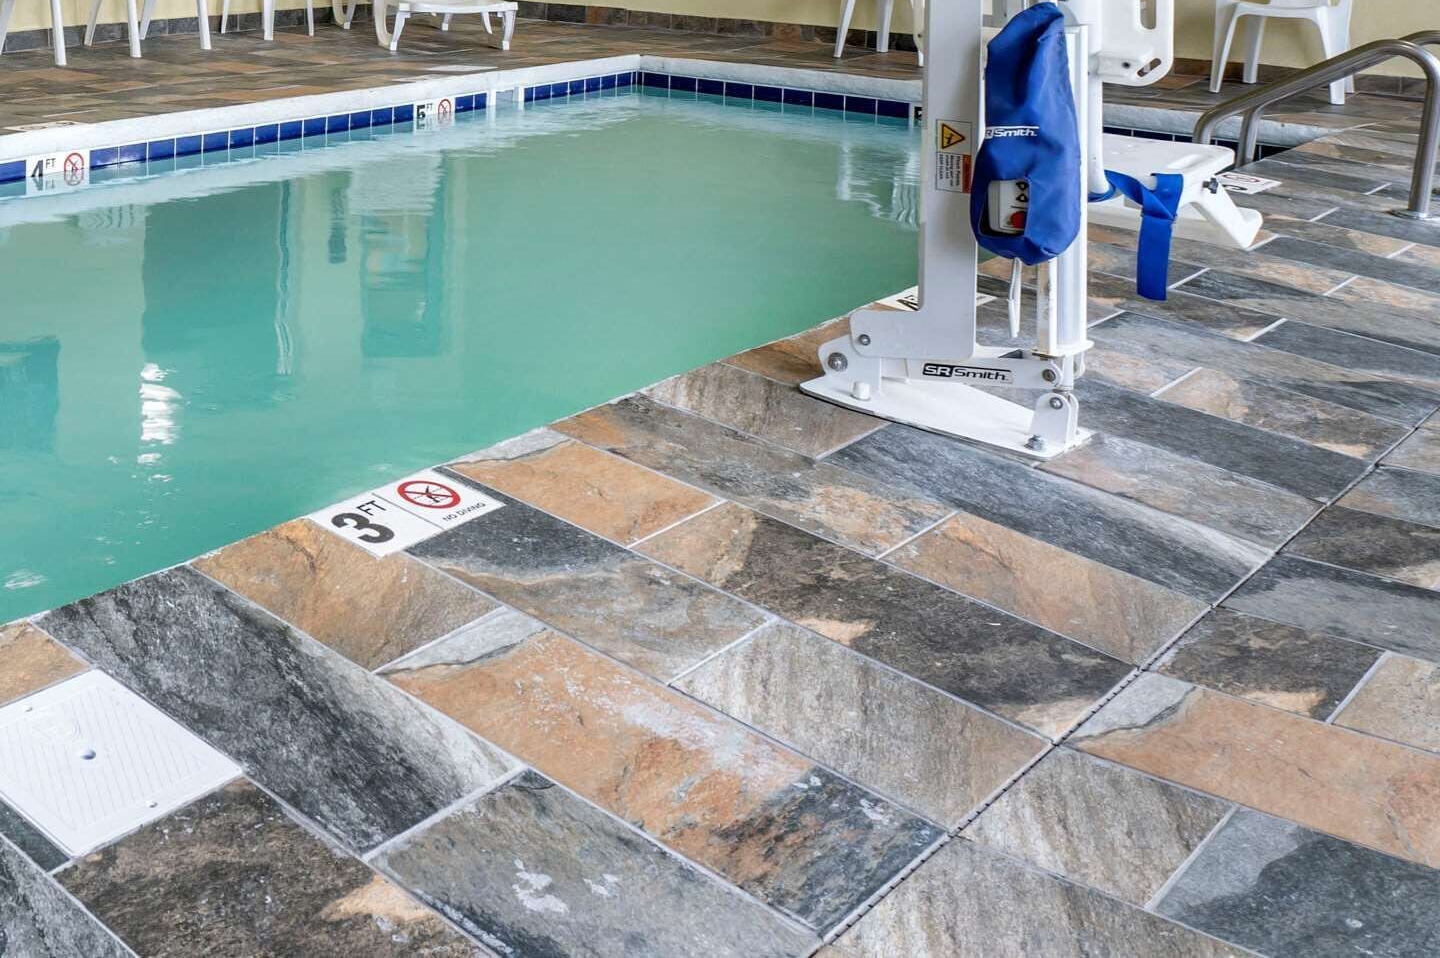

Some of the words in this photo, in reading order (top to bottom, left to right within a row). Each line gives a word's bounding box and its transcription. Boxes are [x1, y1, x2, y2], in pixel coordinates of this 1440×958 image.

[416, 104, 426, 119] 5
[994, 128, 1035, 138] Smith
[45, 158, 56, 169] FT
[924, 364, 951, 377] SR
[954, 367, 1006, 380] Smith
[357, 500, 387, 516] FT
[443, 513, 459, 522] NO
[457, 502, 486, 517] DIVING
[330, 512, 395, 543] 3
